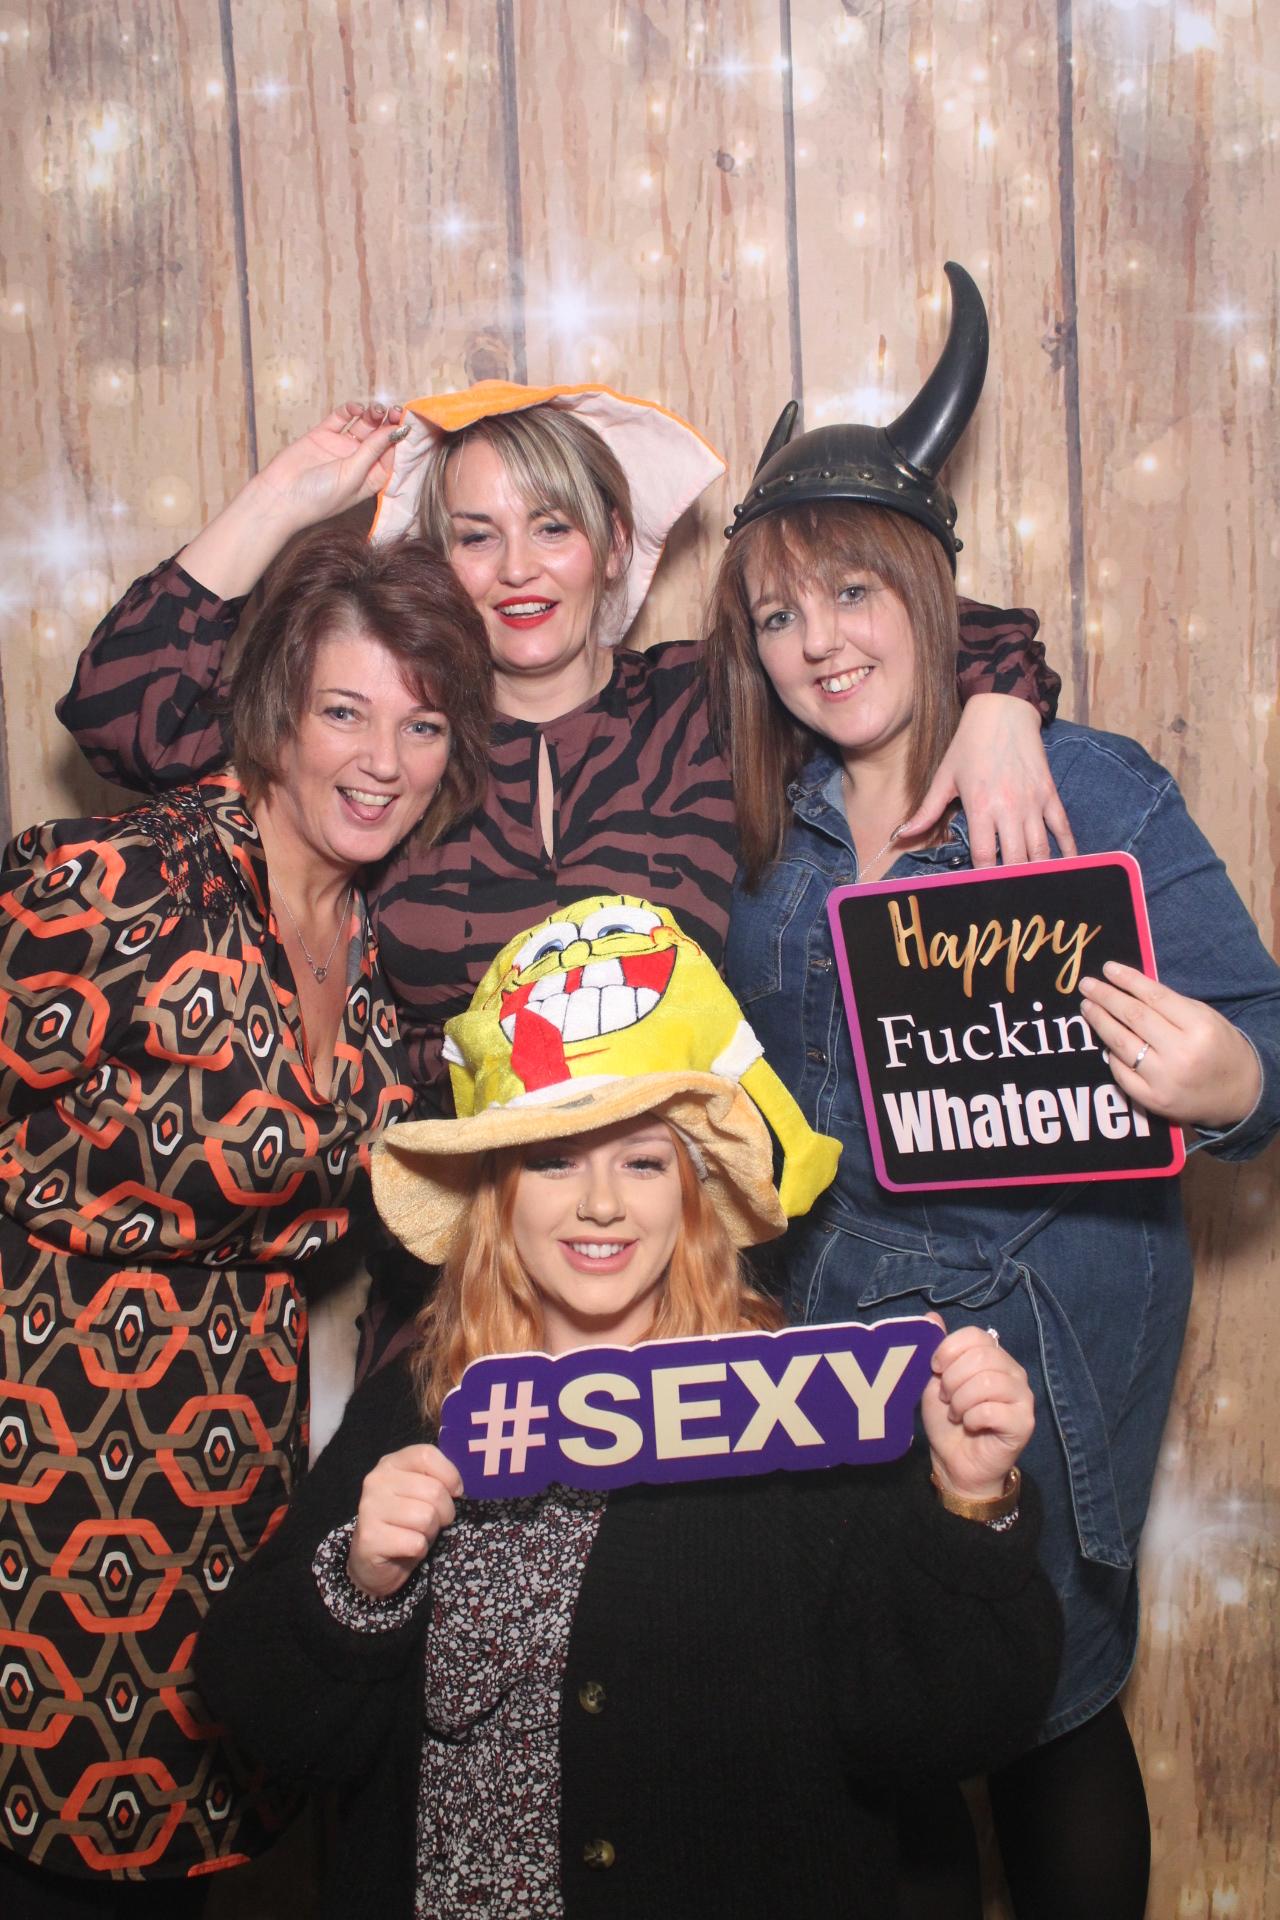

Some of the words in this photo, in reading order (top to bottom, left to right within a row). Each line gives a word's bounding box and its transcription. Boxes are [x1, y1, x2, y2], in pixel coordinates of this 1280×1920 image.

[887, 895, 1102, 998] Happy
[876, 1001, 1110, 1069] Fuckin
[468, 1344, 919, 1476] #SEXY
